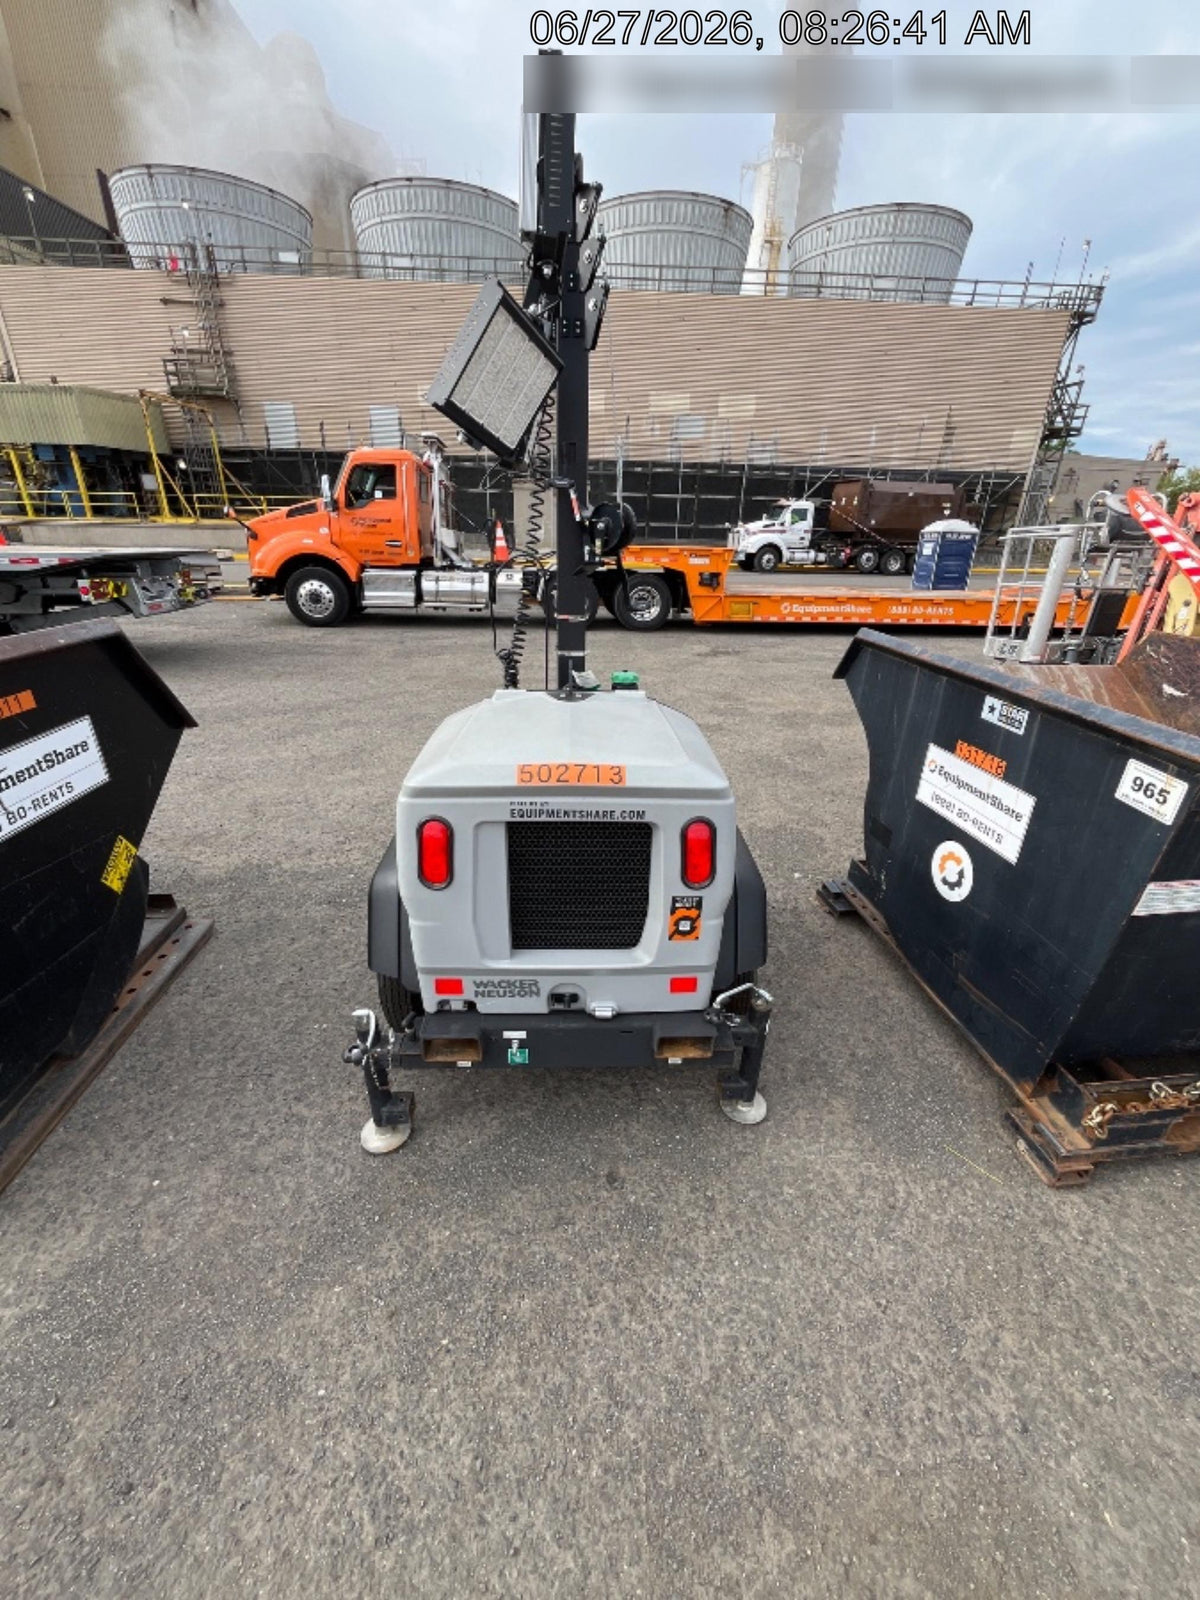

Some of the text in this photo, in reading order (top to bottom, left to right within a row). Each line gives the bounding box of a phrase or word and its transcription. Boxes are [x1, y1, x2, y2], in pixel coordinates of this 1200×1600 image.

[519, 763, 624, 785] 502713
[938, 765, 1024, 822] EquipmentShare
[1130, 776, 1171, 805] 965
[509, 808, 646, 820] EQUIPMENTSHARE.COM
[473, 979, 540, 990] WACKER
[474, 989, 541, 998] NEUSON
